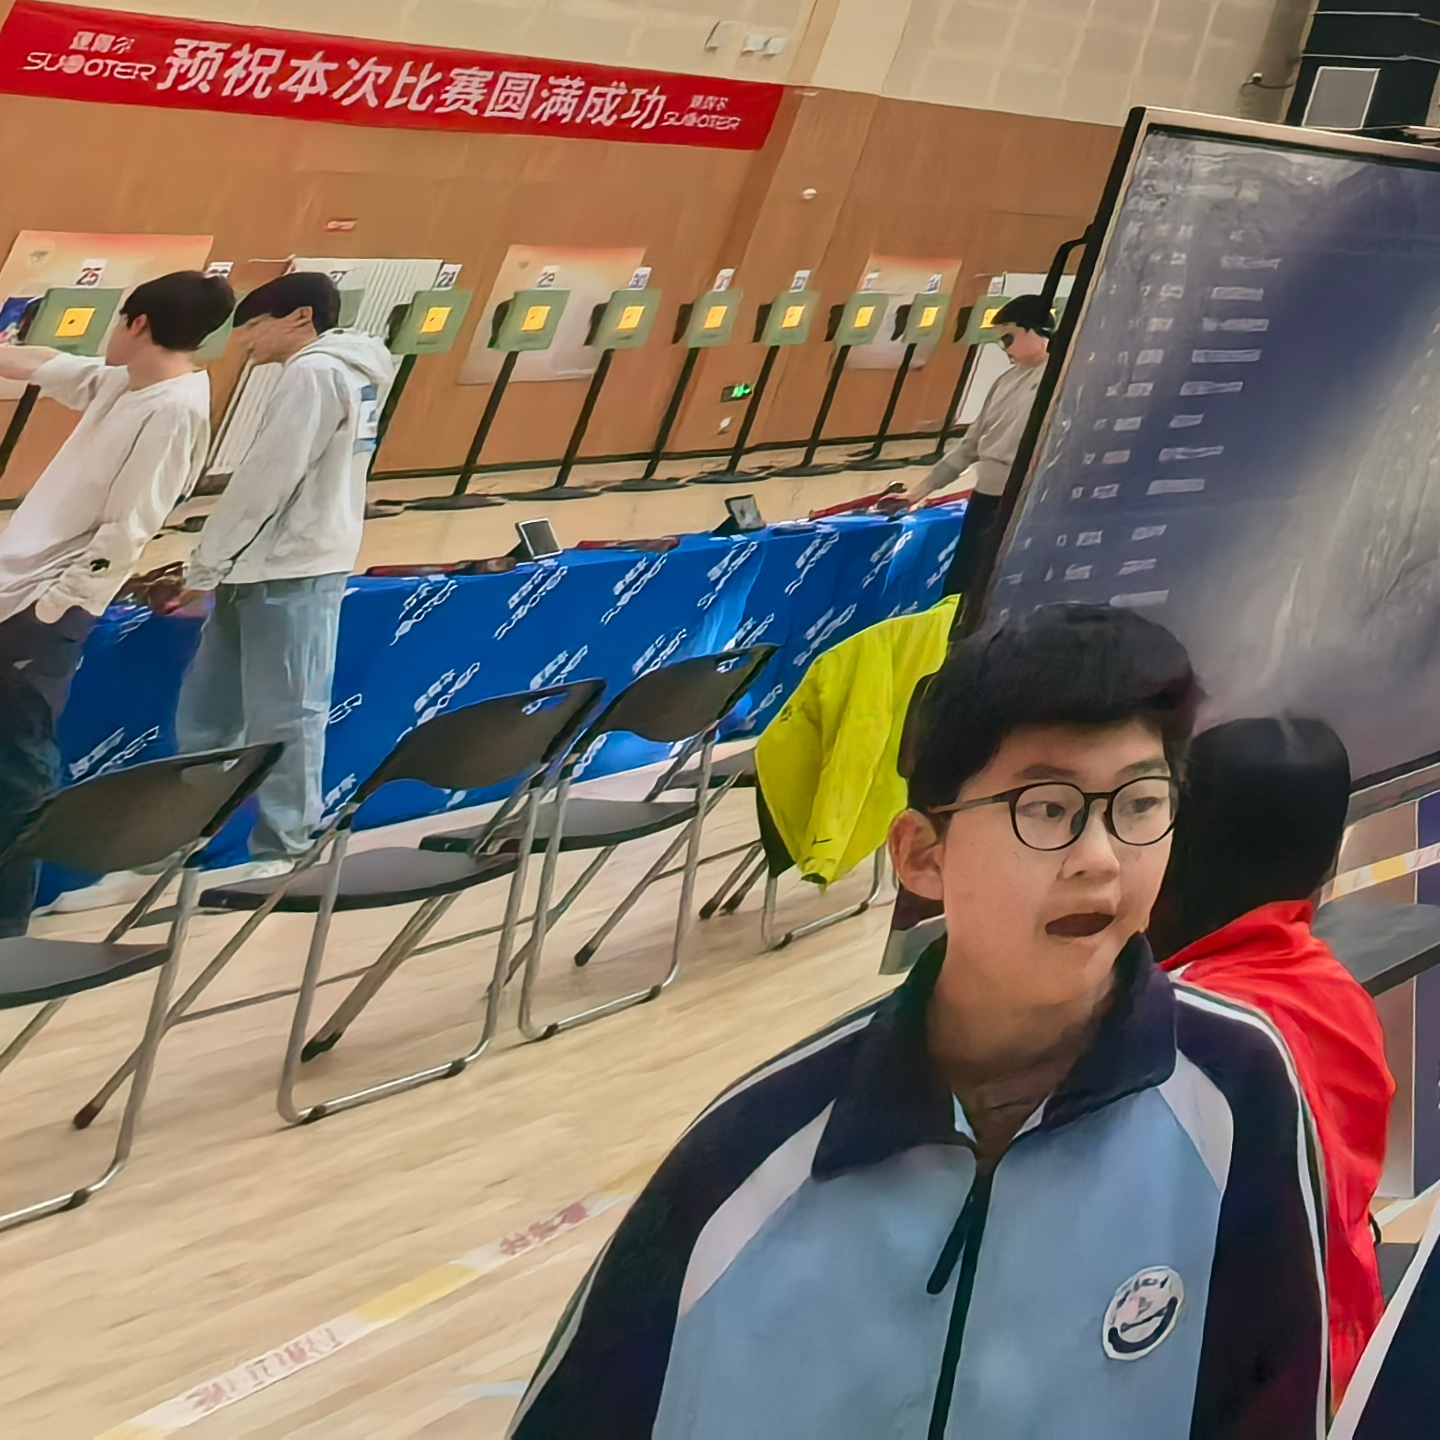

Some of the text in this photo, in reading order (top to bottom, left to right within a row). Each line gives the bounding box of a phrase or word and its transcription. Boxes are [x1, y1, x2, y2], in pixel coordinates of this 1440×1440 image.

[156, 37, 668, 131] 预祝本次比赛圆满成功
